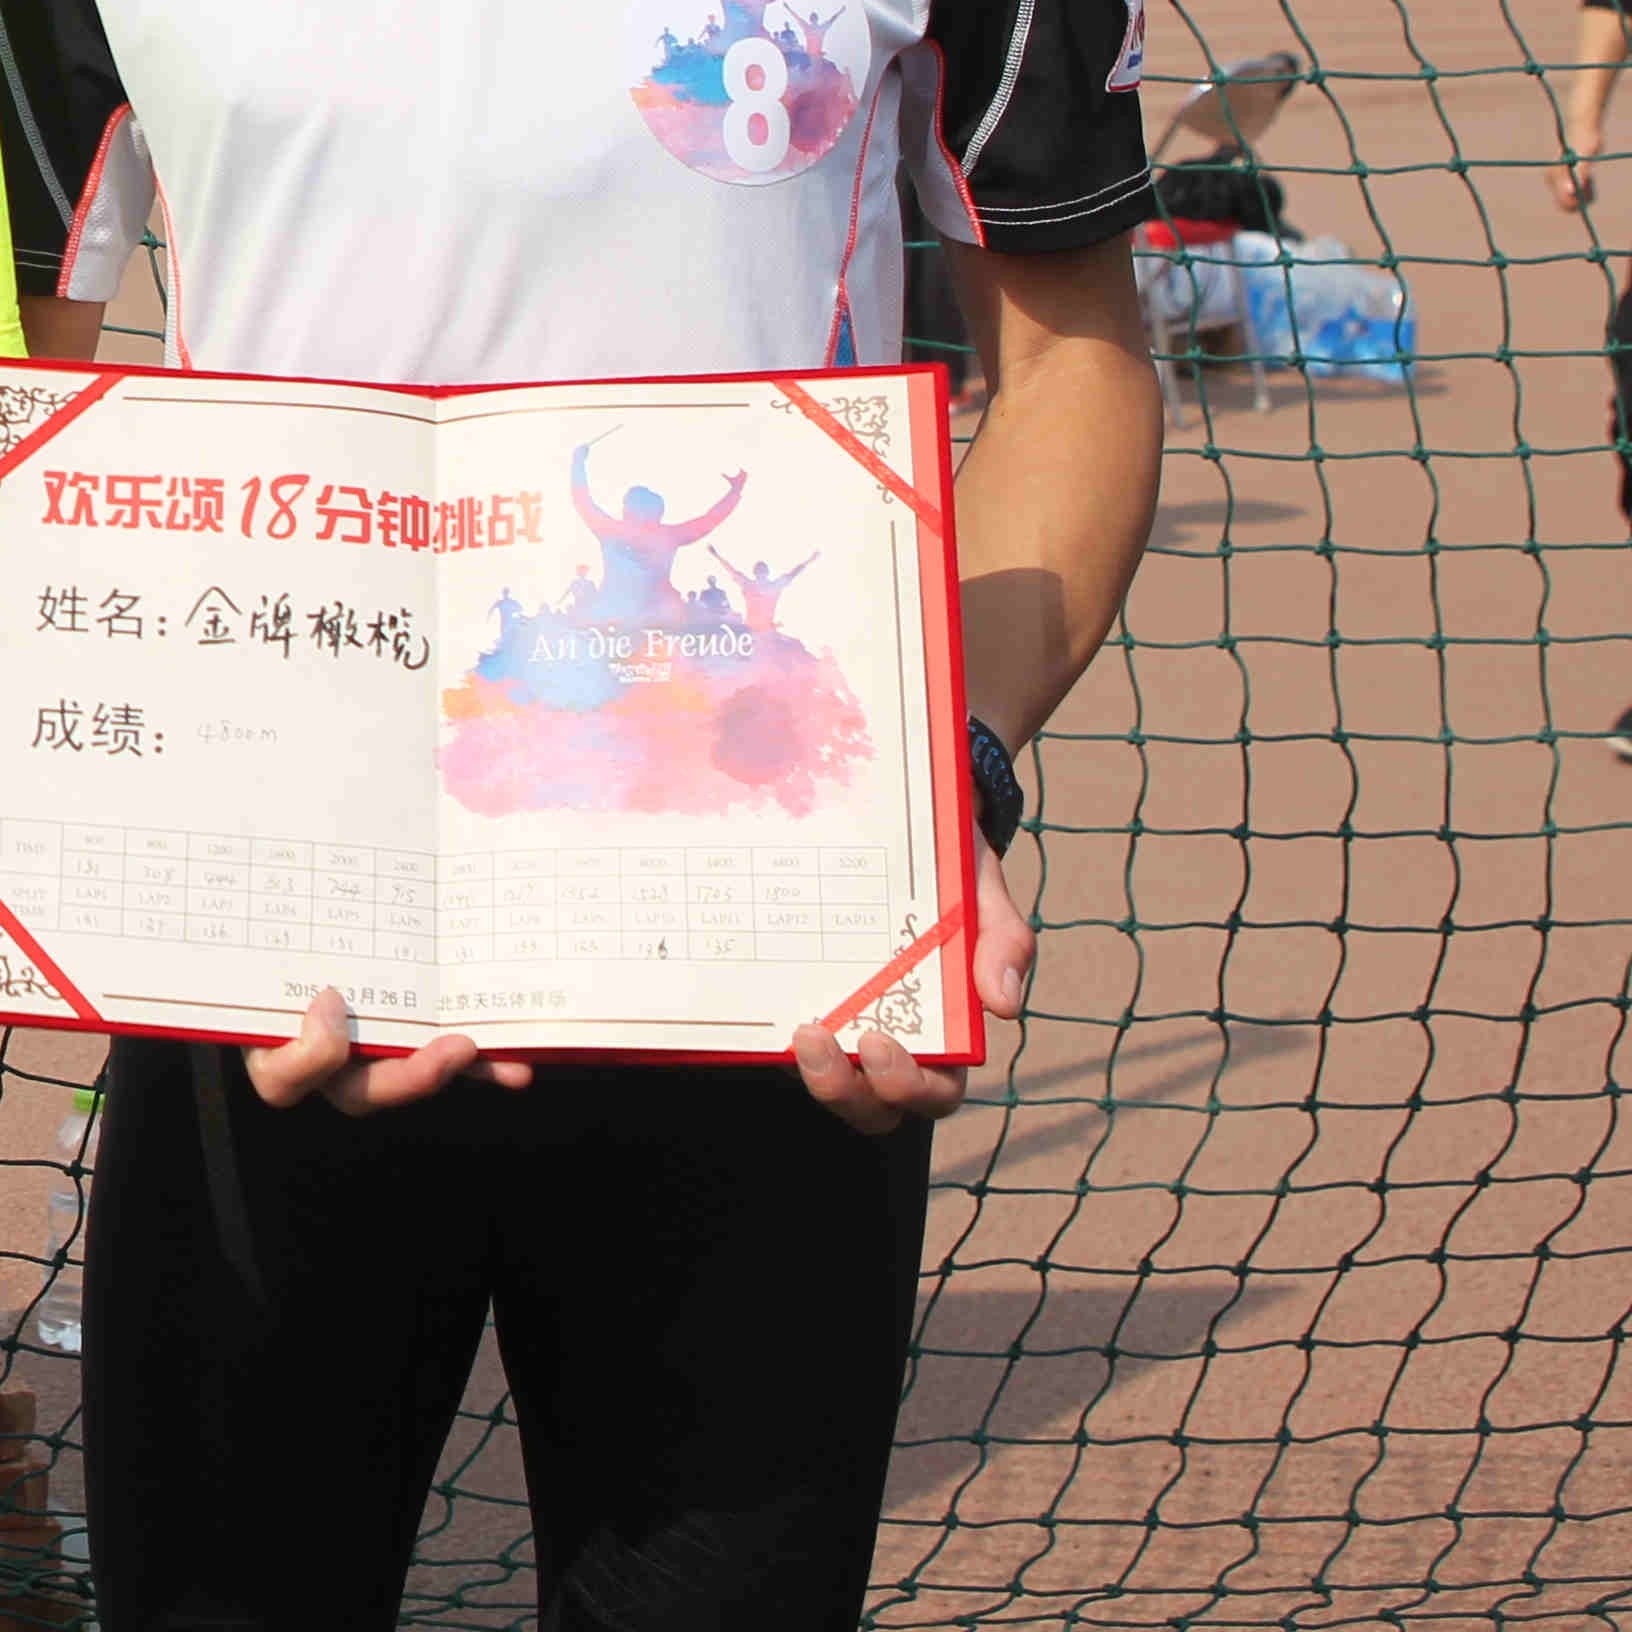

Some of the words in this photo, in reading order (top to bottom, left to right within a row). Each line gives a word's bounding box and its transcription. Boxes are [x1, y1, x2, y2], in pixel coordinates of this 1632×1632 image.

[723, 36, 791, 172] 8
[528, 634, 576, 662] An
[588, 627, 633, 658] die
[644, 624, 753, 657] Freude
